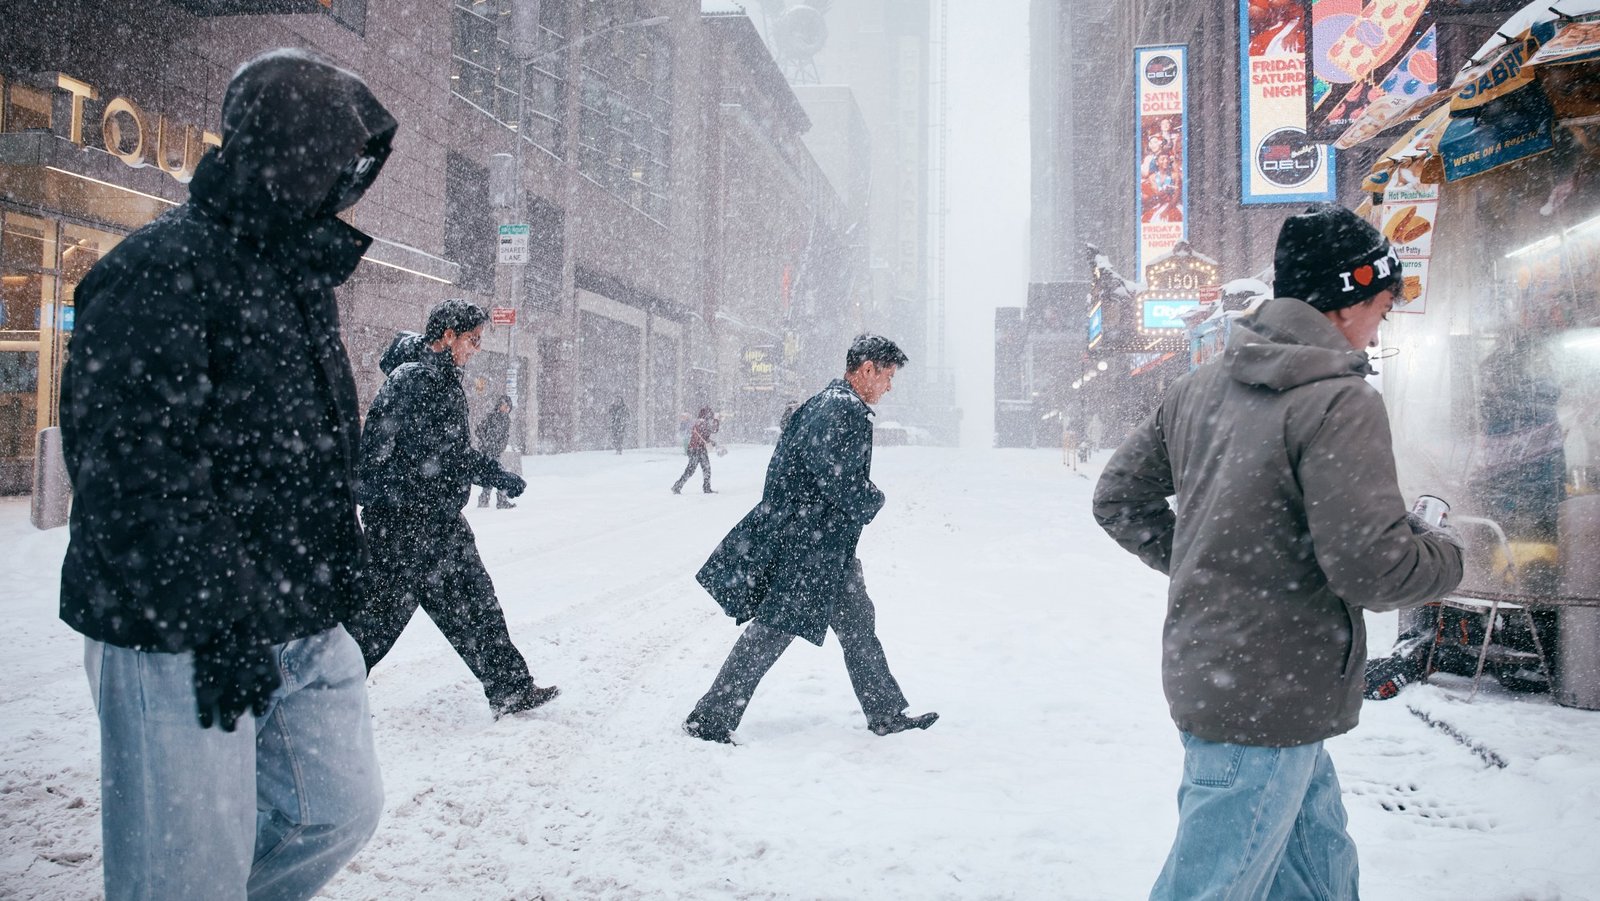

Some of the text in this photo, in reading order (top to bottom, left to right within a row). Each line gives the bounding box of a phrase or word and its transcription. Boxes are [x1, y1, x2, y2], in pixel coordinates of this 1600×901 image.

[1252, 73, 1306, 85] SATURD
[1144, 92, 1179, 102] SATIN
[1142, 102, 1181, 112] DOLLZ
[57, 73, 222, 184] TOU
[1453, 151, 1480, 167] WE'RE
[1483, 146, 1494, 157] ON
[1495, 142, 1502, 153] A
[1504, 135, 1526, 148] ROLL
[1263, 159, 1314, 171] DELI
[1388, 191, 1399, 200] Hot
[500, 246, 526, 254] SHARED
[1405, 246, 1420, 255] Patty
[1168, 273, 1199, 290] 1501
[1339, 271, 1354, 292] I
